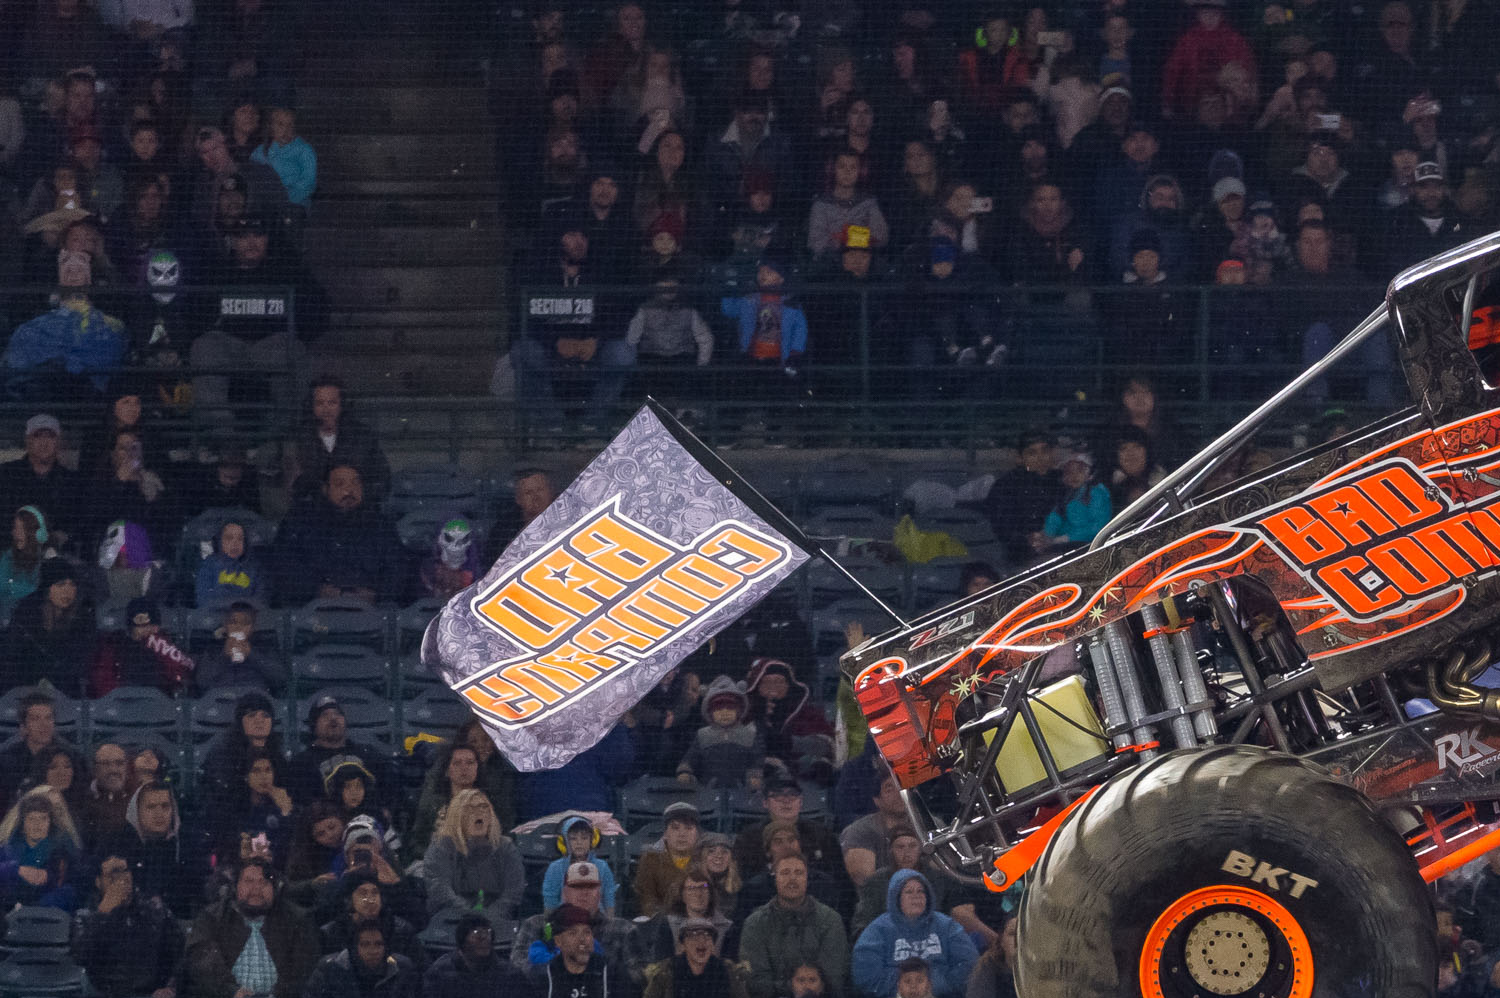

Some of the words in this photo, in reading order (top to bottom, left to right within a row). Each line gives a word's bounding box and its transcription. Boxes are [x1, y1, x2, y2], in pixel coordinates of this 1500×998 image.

[1257, 467, 1443, 565] BAD
[1434, 726, 1497, 770] RK
[1220, 850, 1319, 899] BKT
